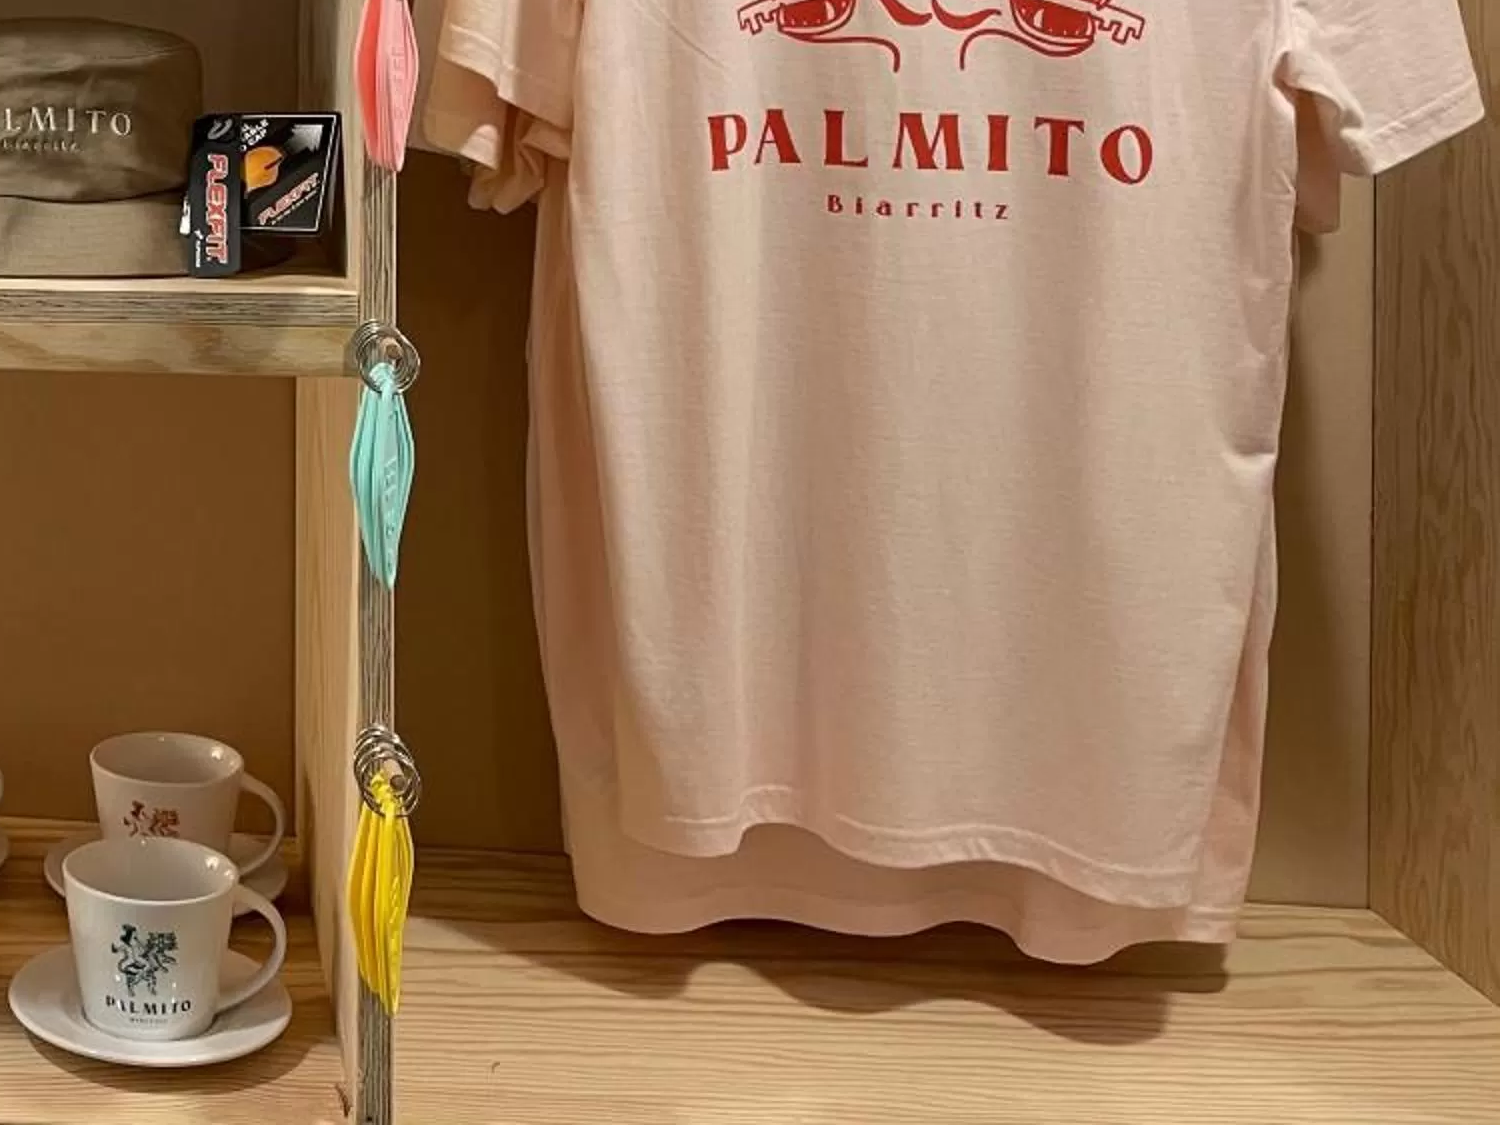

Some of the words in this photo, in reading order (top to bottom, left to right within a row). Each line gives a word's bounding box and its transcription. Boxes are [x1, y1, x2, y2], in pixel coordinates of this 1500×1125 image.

[707, 108, 1153, 185] PALMITO
[206, 154, 229, 264] FLEXFIT
[826, 193, 1009, 220] Biarritz
[105, 994, 192, 1015] PALMITO
